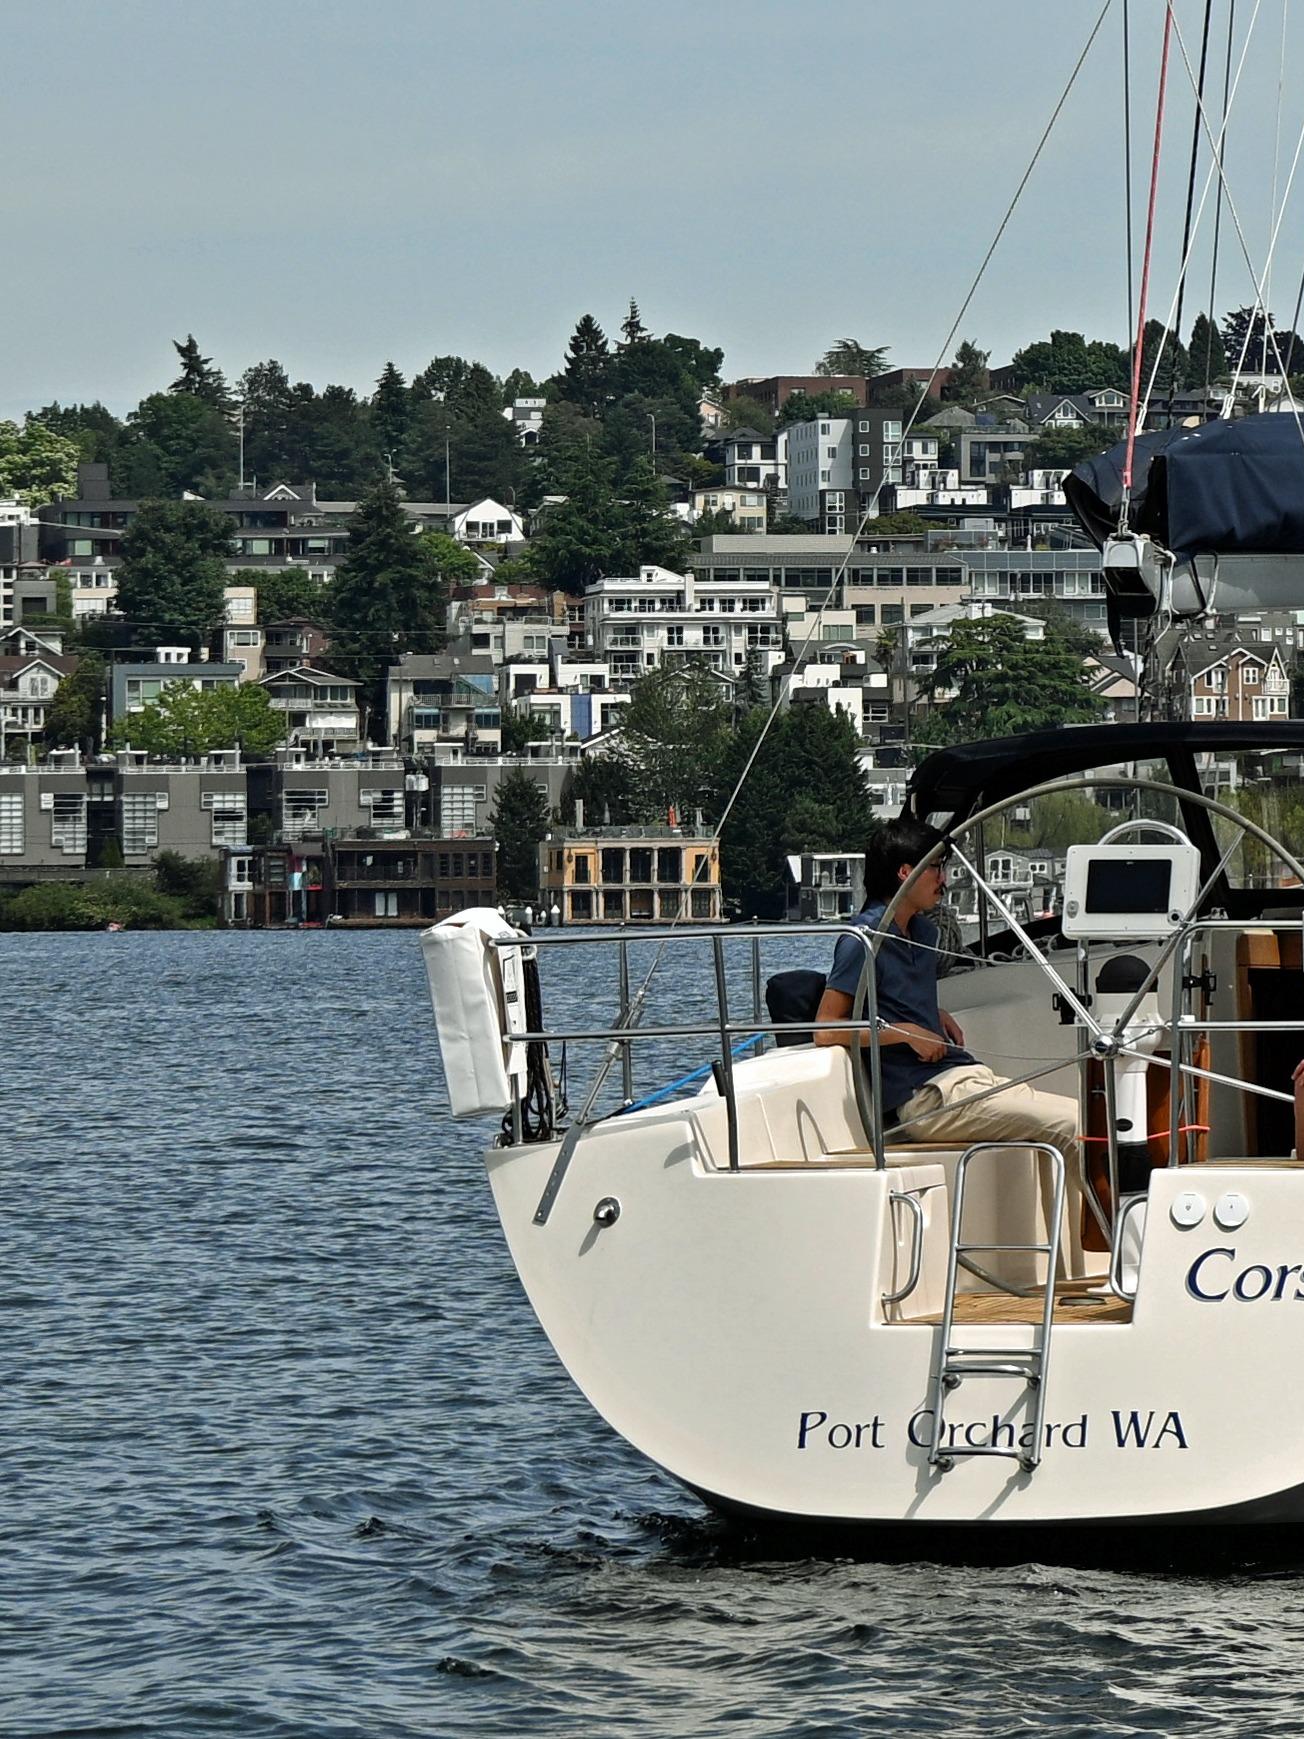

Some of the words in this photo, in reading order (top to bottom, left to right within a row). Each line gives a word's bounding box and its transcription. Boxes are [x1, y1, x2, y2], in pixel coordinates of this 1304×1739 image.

[797, 1411, 885, 1449] Port
[907, 1410, 1088, 1448] Orchard
[1110, 1410, 1189, 1449] WA
